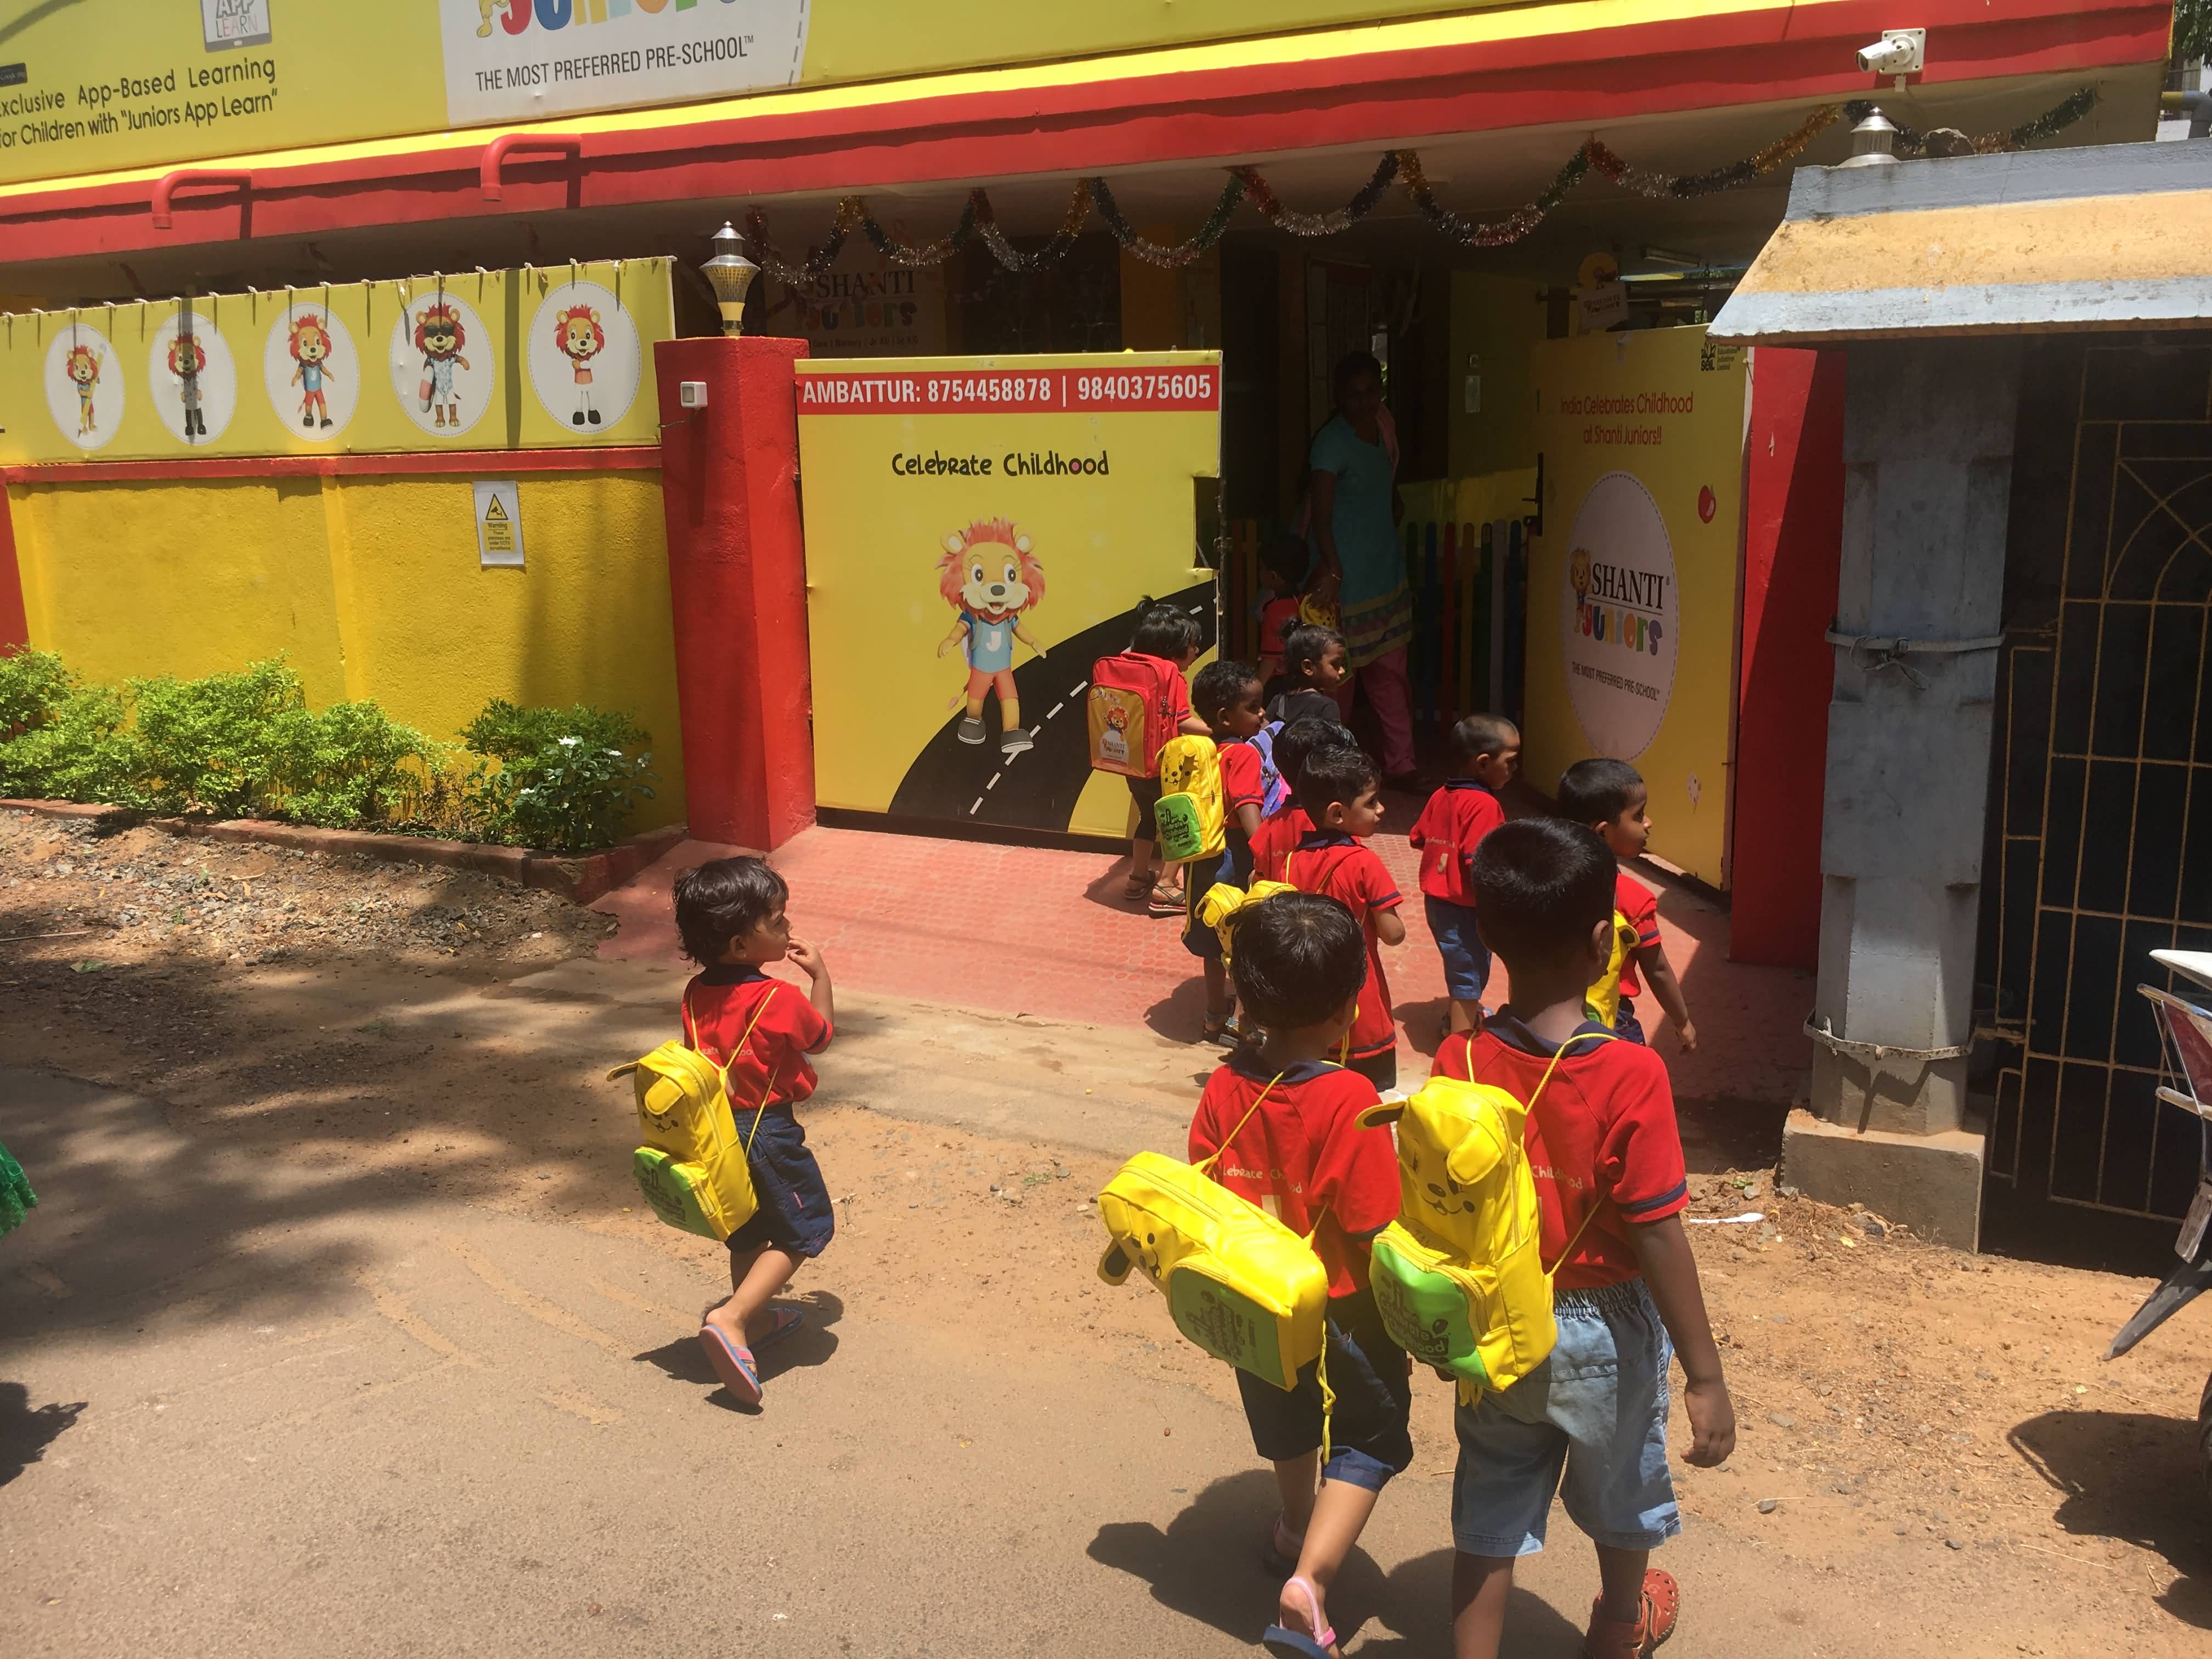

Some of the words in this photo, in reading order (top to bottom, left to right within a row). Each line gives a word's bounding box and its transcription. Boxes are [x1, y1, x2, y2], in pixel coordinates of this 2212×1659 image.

[216, 14, 258, 38] LEARN
[476, 69, 503, 92] THE
[507, 63, 549, 88] MOST
[554, 50, 641, 82] PREFERRED
[0, 89, 65, 117] xclusive
[78, 69, 176, 110] App-Based
[188, 57, 275, 88] Learning
[0, 129, 17, 149] or
[21, 120, 84, 145] Children
[88, 111, 119, 136] with
[185, 101, 218, 127] App
[816, 270, 916, 298] SHANTI
[803, 380, 921, 403] AMBATTUR:
[928, 378, 1051, 403] 8754458878
[1078, 374, 1211, 400] 9840375605
[1561, 396, 1582, 415] India
[1584, 394, 1634, 415] Celebrates
[1637, 391, 1694, 414] Childhood
[1583, 425, 1592, 444] at
[1594, 424, 1622, 444] Shanti
[1572, 661, 1581, 675] THE
[1581, 665, 1595, 680] MOST
[1595, 669, 1623, 690] PREFERRED
